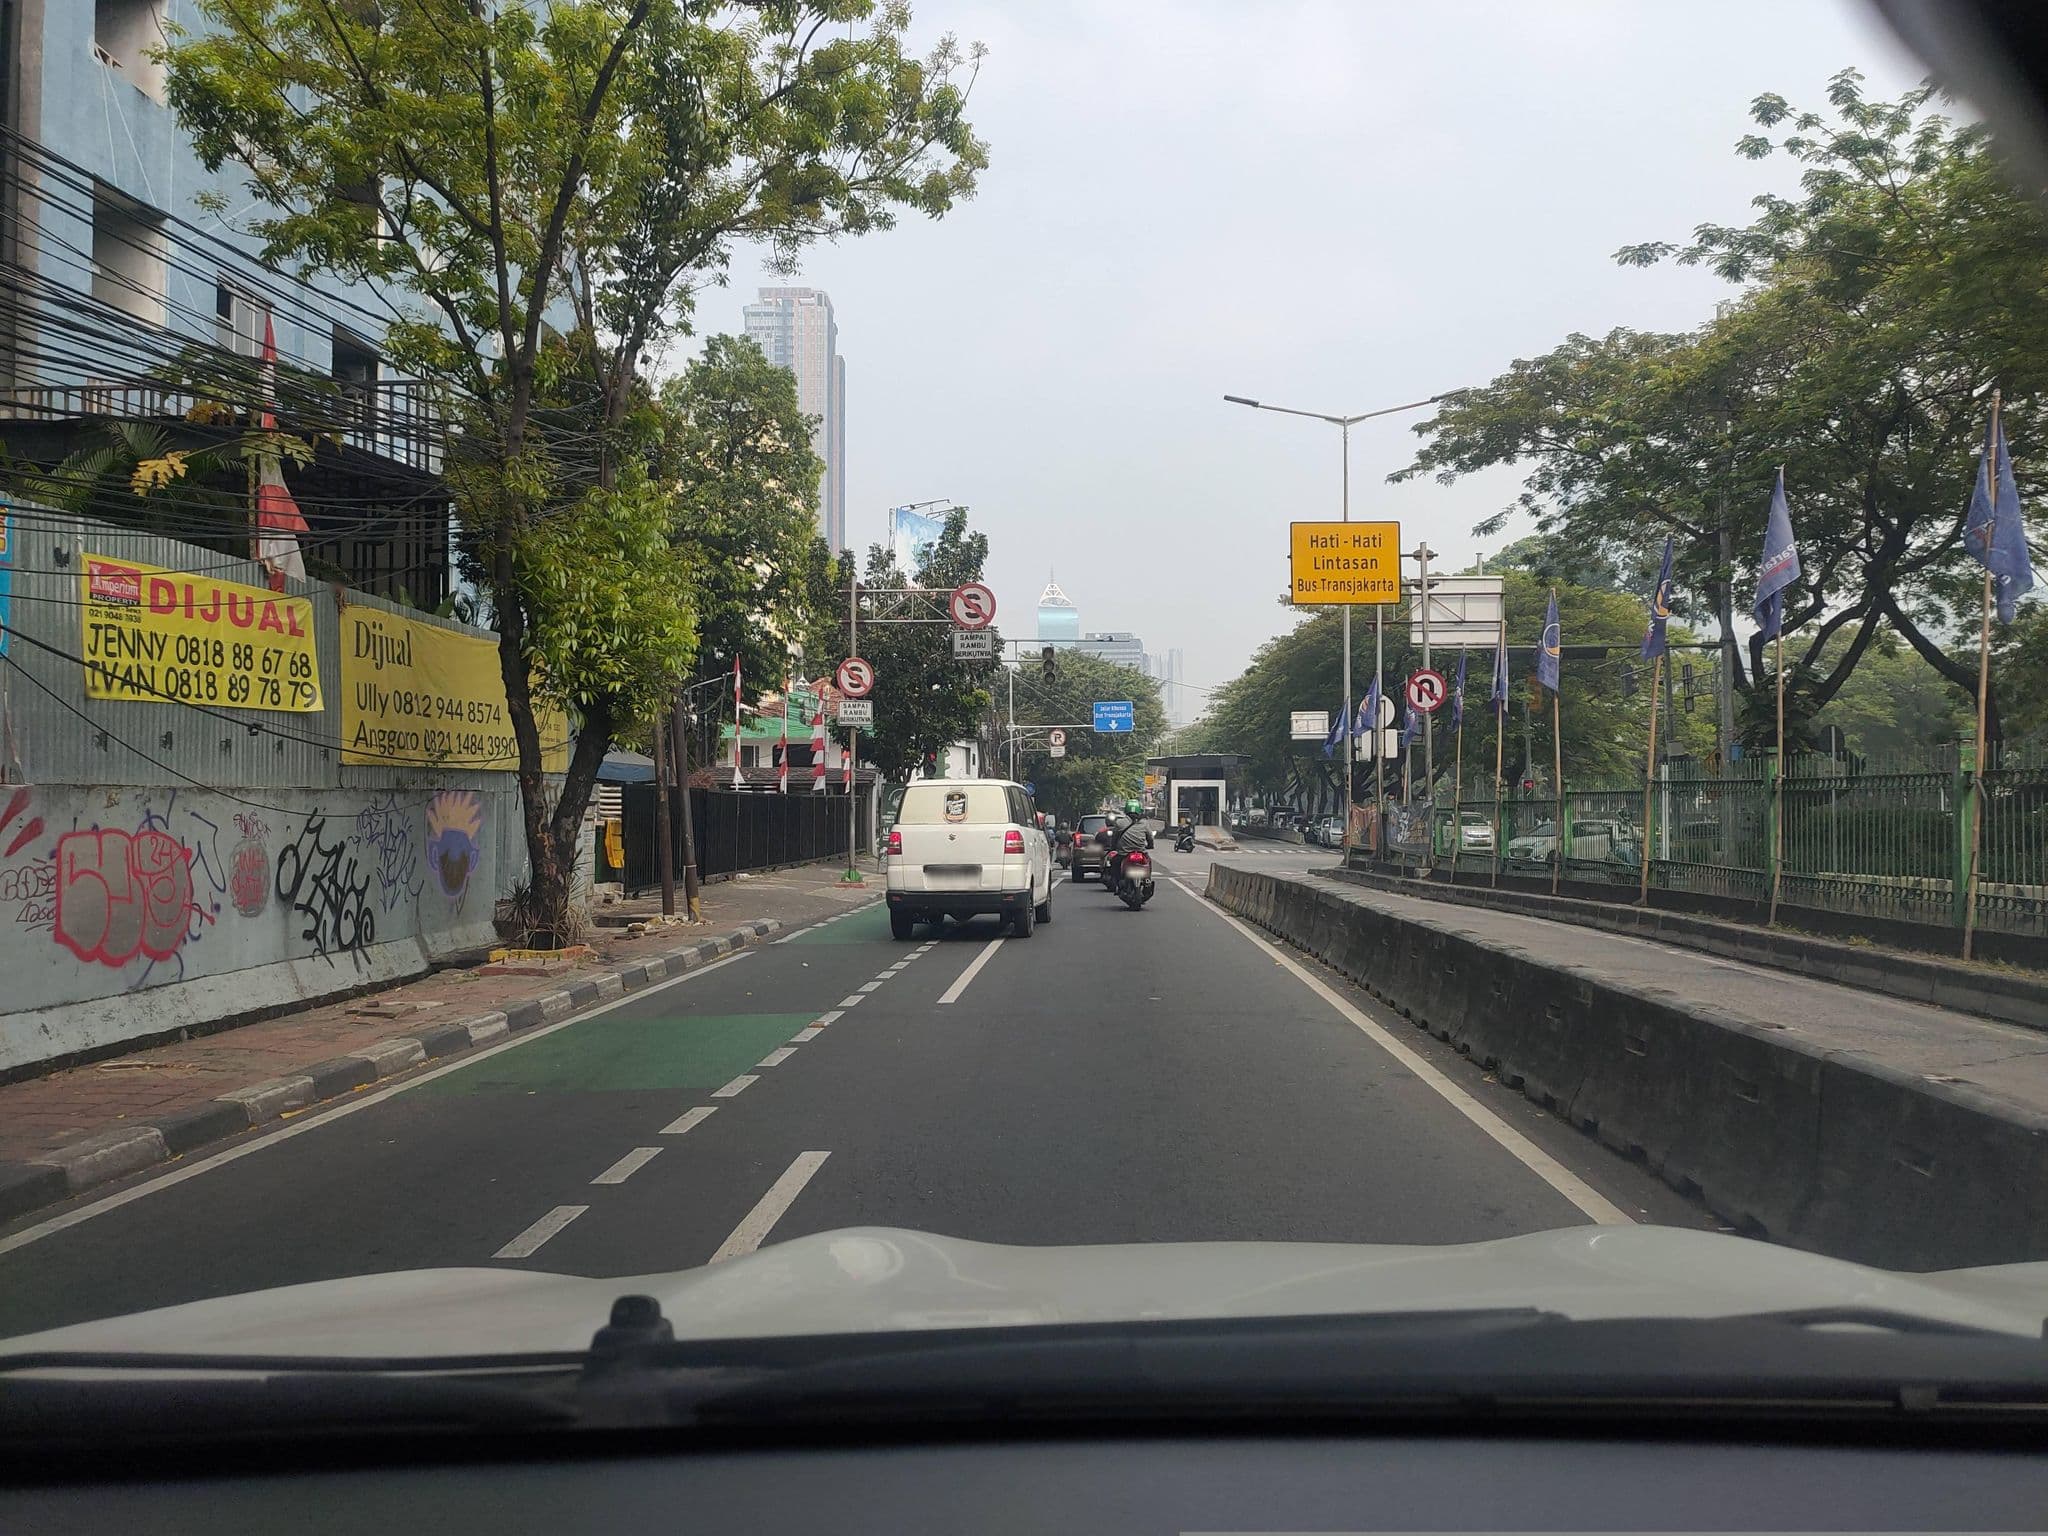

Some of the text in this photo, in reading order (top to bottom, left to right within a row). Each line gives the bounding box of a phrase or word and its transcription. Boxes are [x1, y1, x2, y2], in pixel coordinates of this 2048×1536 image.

[1310, 533, 1339, 548] Hati
[1352, 533, 1382, 548] Hati
[1313, 555, 1378, 570] Lintasan
[92, 593, 138, 606] PROPERTY
[1297, 576, 1394, 596] Bus Transjakarta
[149, 577, 305, 638] DIJUAL
[87, 623, 312, 679] JENNY 0818 88 67 68
[353, 619, 413, 671] Dijual
[88, 660, 318, 708] IVAN 0818 89 78 79
[356, 682, 501, 725] Ully 0812 944 8574
[353, 719, 516, 757] Anggoro 0821 1484 3990
